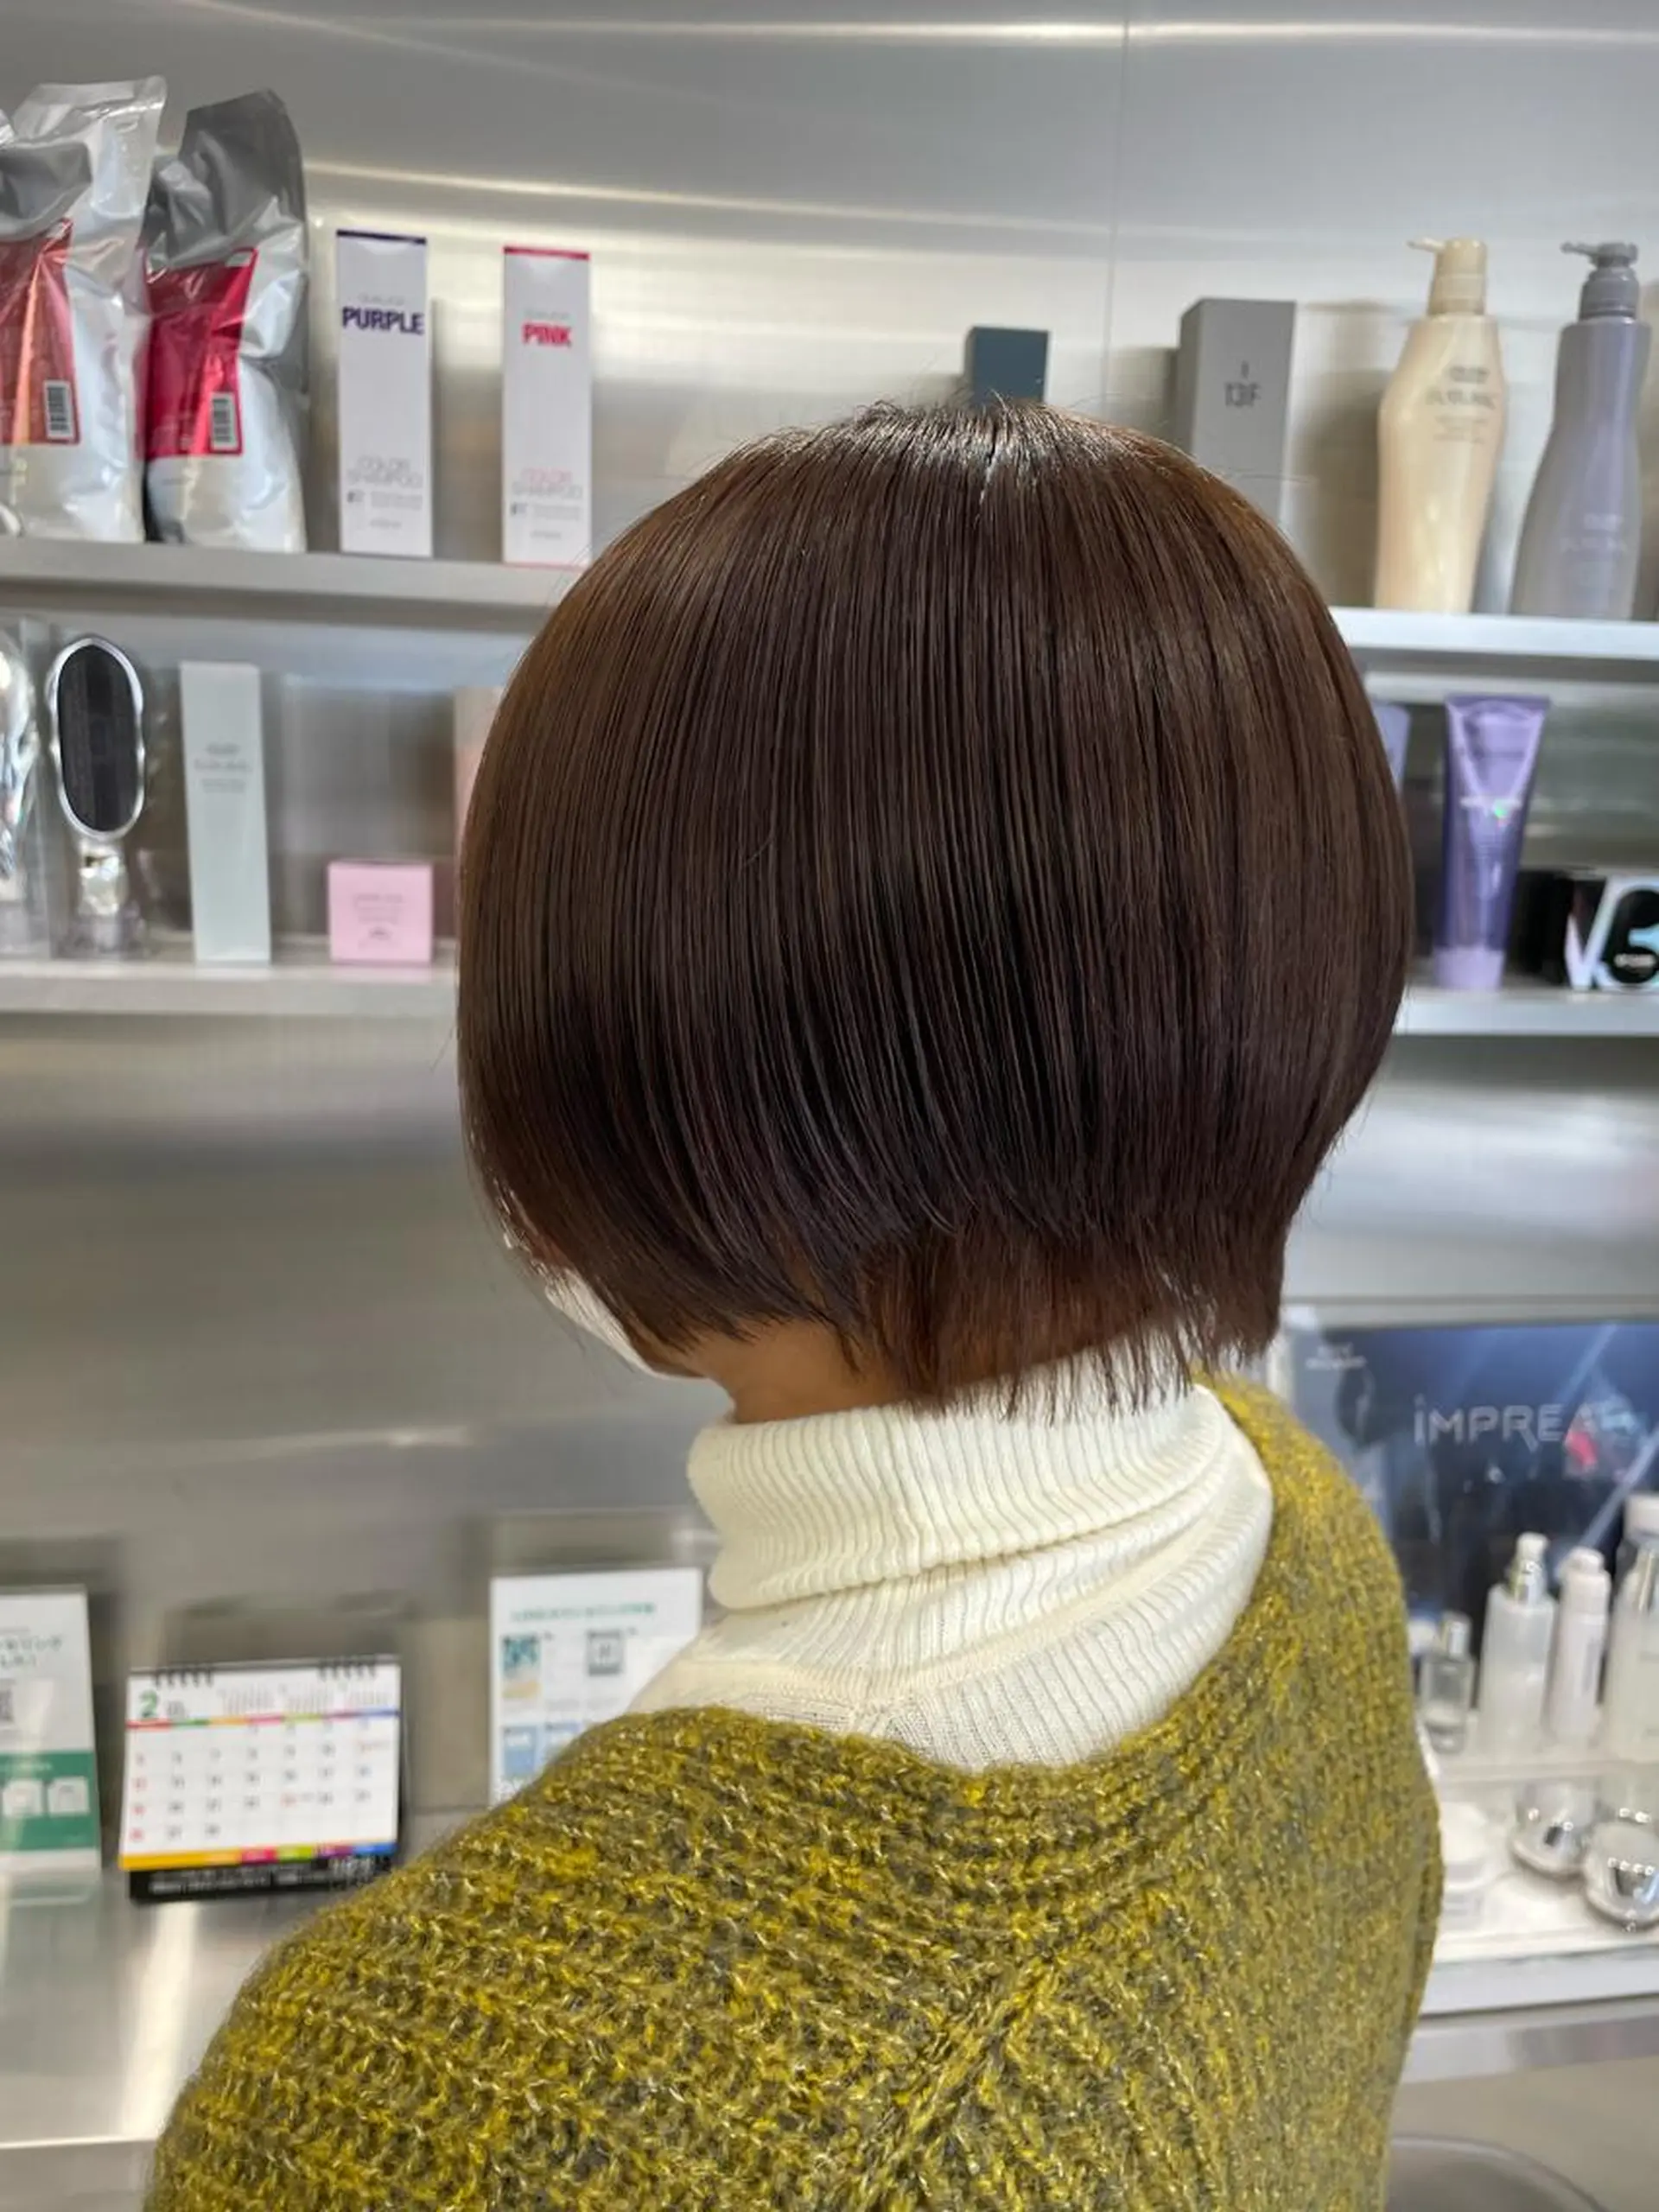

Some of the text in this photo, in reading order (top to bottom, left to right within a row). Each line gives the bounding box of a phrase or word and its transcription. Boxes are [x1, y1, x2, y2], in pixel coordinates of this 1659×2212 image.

[341, 306, 424, 335] PURPLE
[522, 321, 572, 347] PINK
[138, 1689, 160, 1719] 2
